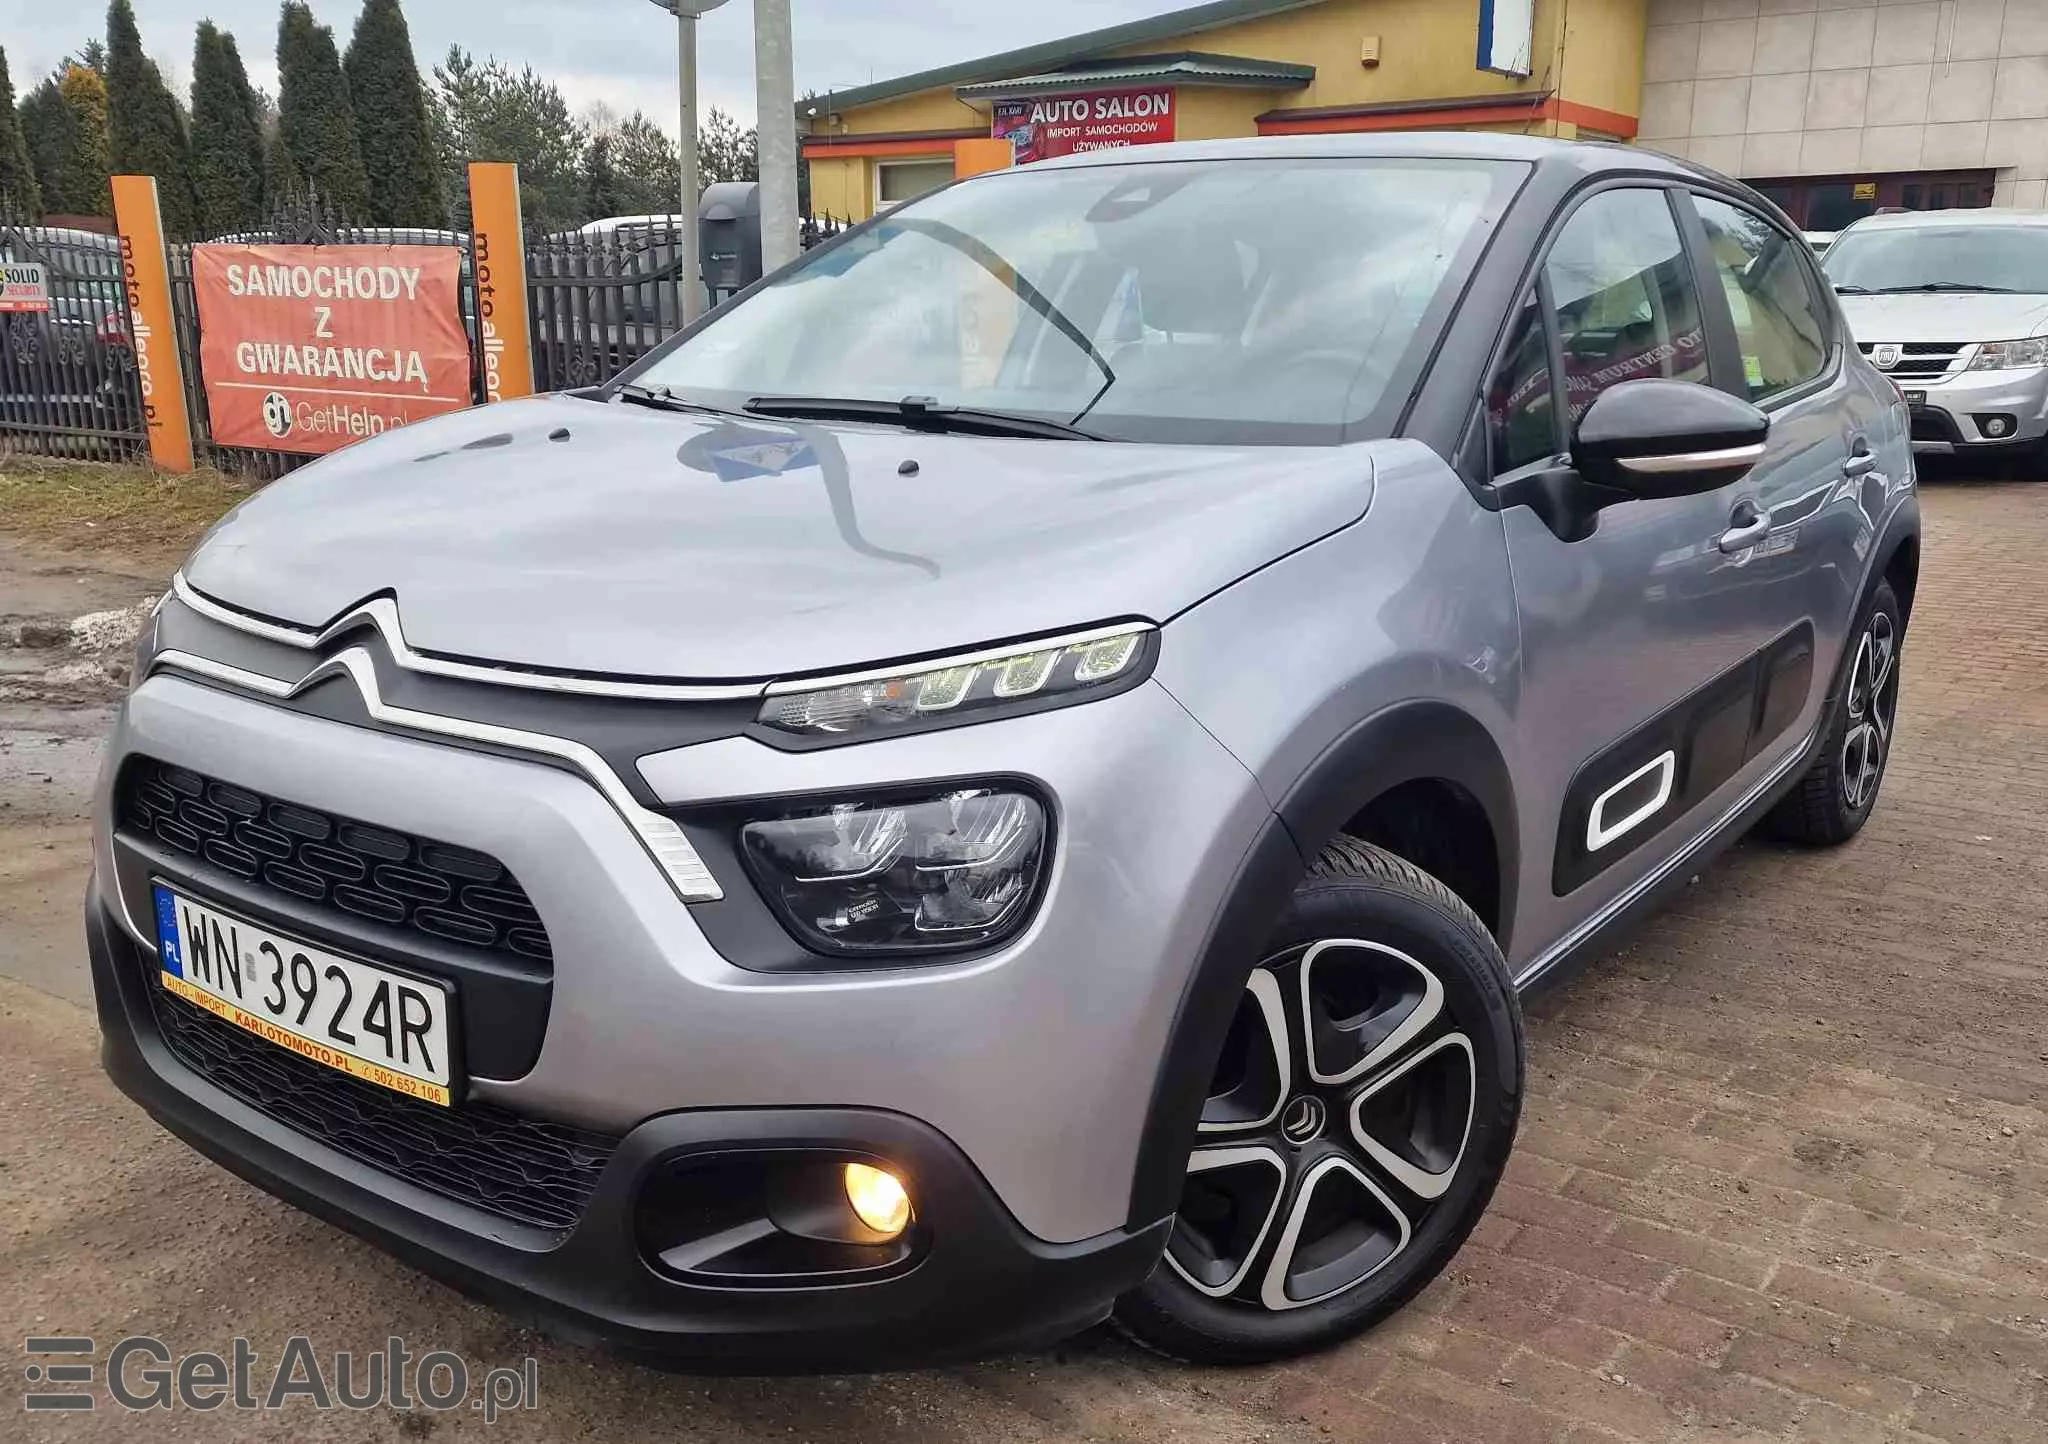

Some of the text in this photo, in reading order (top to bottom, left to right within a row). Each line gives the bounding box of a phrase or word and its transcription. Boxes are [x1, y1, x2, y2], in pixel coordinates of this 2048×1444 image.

[1030, 93, 1169, 123] AUTO SALON
[1047, 121, 1158, 138] IMPORT SAMOCHODÓW
[5, 269, 40, 284] SOLID
[227, 264, 420, 300] SAMOCHODY
[314, 306, 333, 338] Z
[236, 341, 429, 393] GWARANCJĄ
[165, 940, 181, 963] PL
[183, 905, 436, 1074] WN 3924R
[167, 977, 189, 996] AUTO
[194, 990, 226, 1016] IMPORT
[234, 1010, 353, 1073] KARI.OTOMOTO.PL
[374, 1068, 394, 1087] 502
[397, 1076, 417, 1095] 652
[421, 1085, 441, 1103] 106
